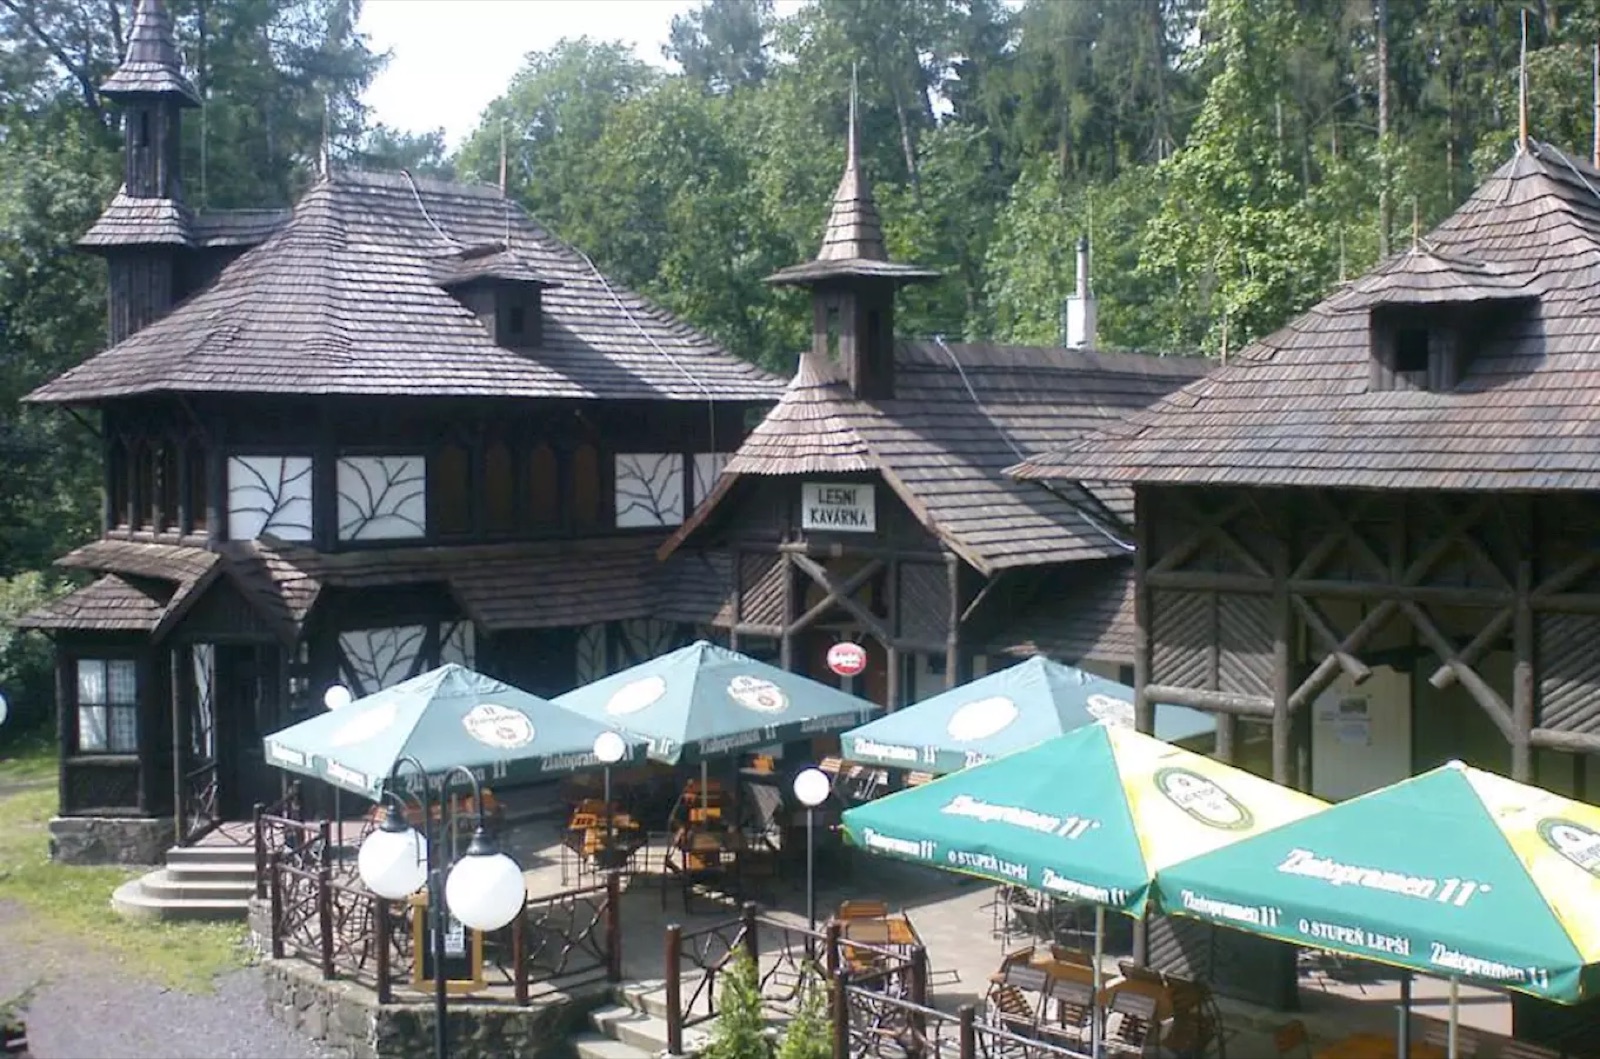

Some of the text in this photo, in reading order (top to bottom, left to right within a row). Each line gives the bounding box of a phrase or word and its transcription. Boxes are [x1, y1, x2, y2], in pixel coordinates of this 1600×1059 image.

[940, 794, 1062, 834] Zlatopramen
[948, 849, 956, 864] O
[1278, 848, 1437, 899] Zlatopramen
[1041, 867, 1109, 905] Zlatopramen
[1180, 888, 1260, 925] Zlatopramen
[1299, 917, 1309, 934] O
[1310, 920, 1365, 947] STUPEŇ
[1430, 941, 1526, 982] Zlatopramen
